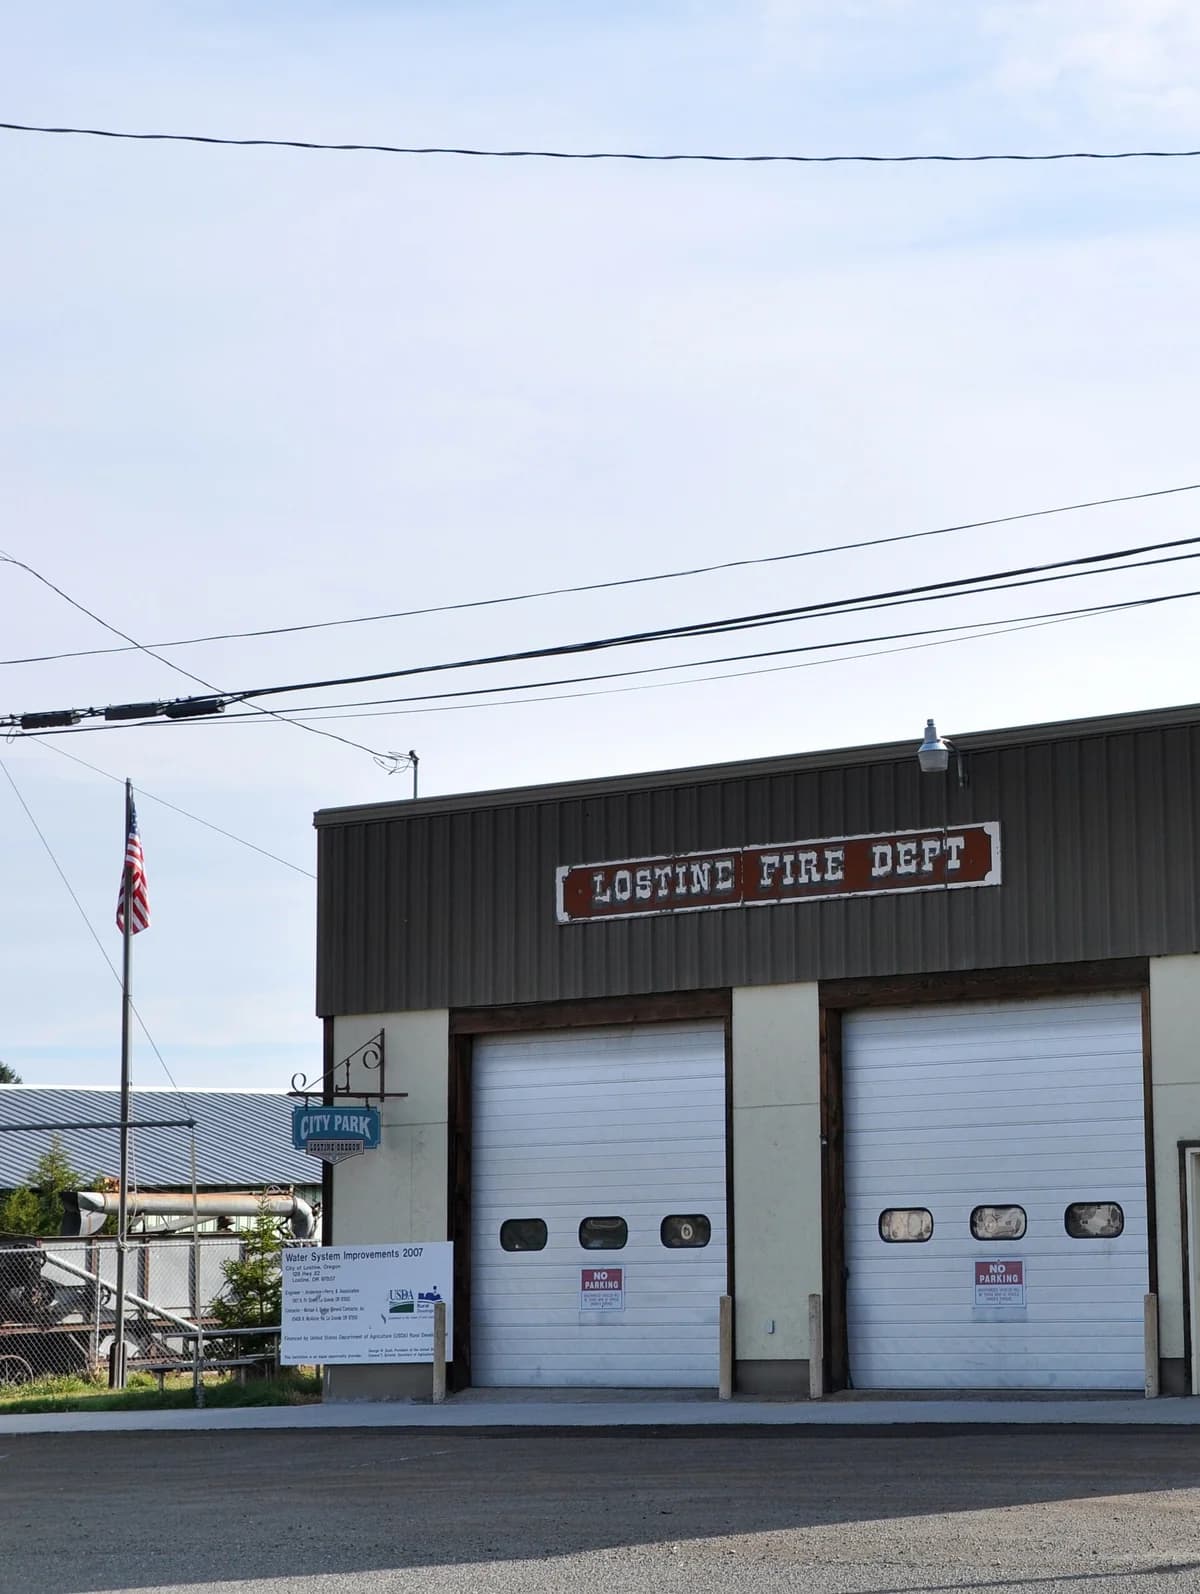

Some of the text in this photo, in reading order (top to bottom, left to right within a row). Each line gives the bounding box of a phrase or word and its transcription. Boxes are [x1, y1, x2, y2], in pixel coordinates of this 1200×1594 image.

[592, 836, 965, 903] LOSTINE FIRE DEPT
[301, 1114, 372, 1140] CITY PARK
[286, 1248, 424, 1262] Water System Improvements 2007
[989, 1264, 1006, 1273] NO
[593, 1272, 608, 1280] NO
[979, 1274, 1018, 1283] PARKING
[585, 1281, 619, 1289] PARKING
[390, 1289, 414, 1300] USDA
